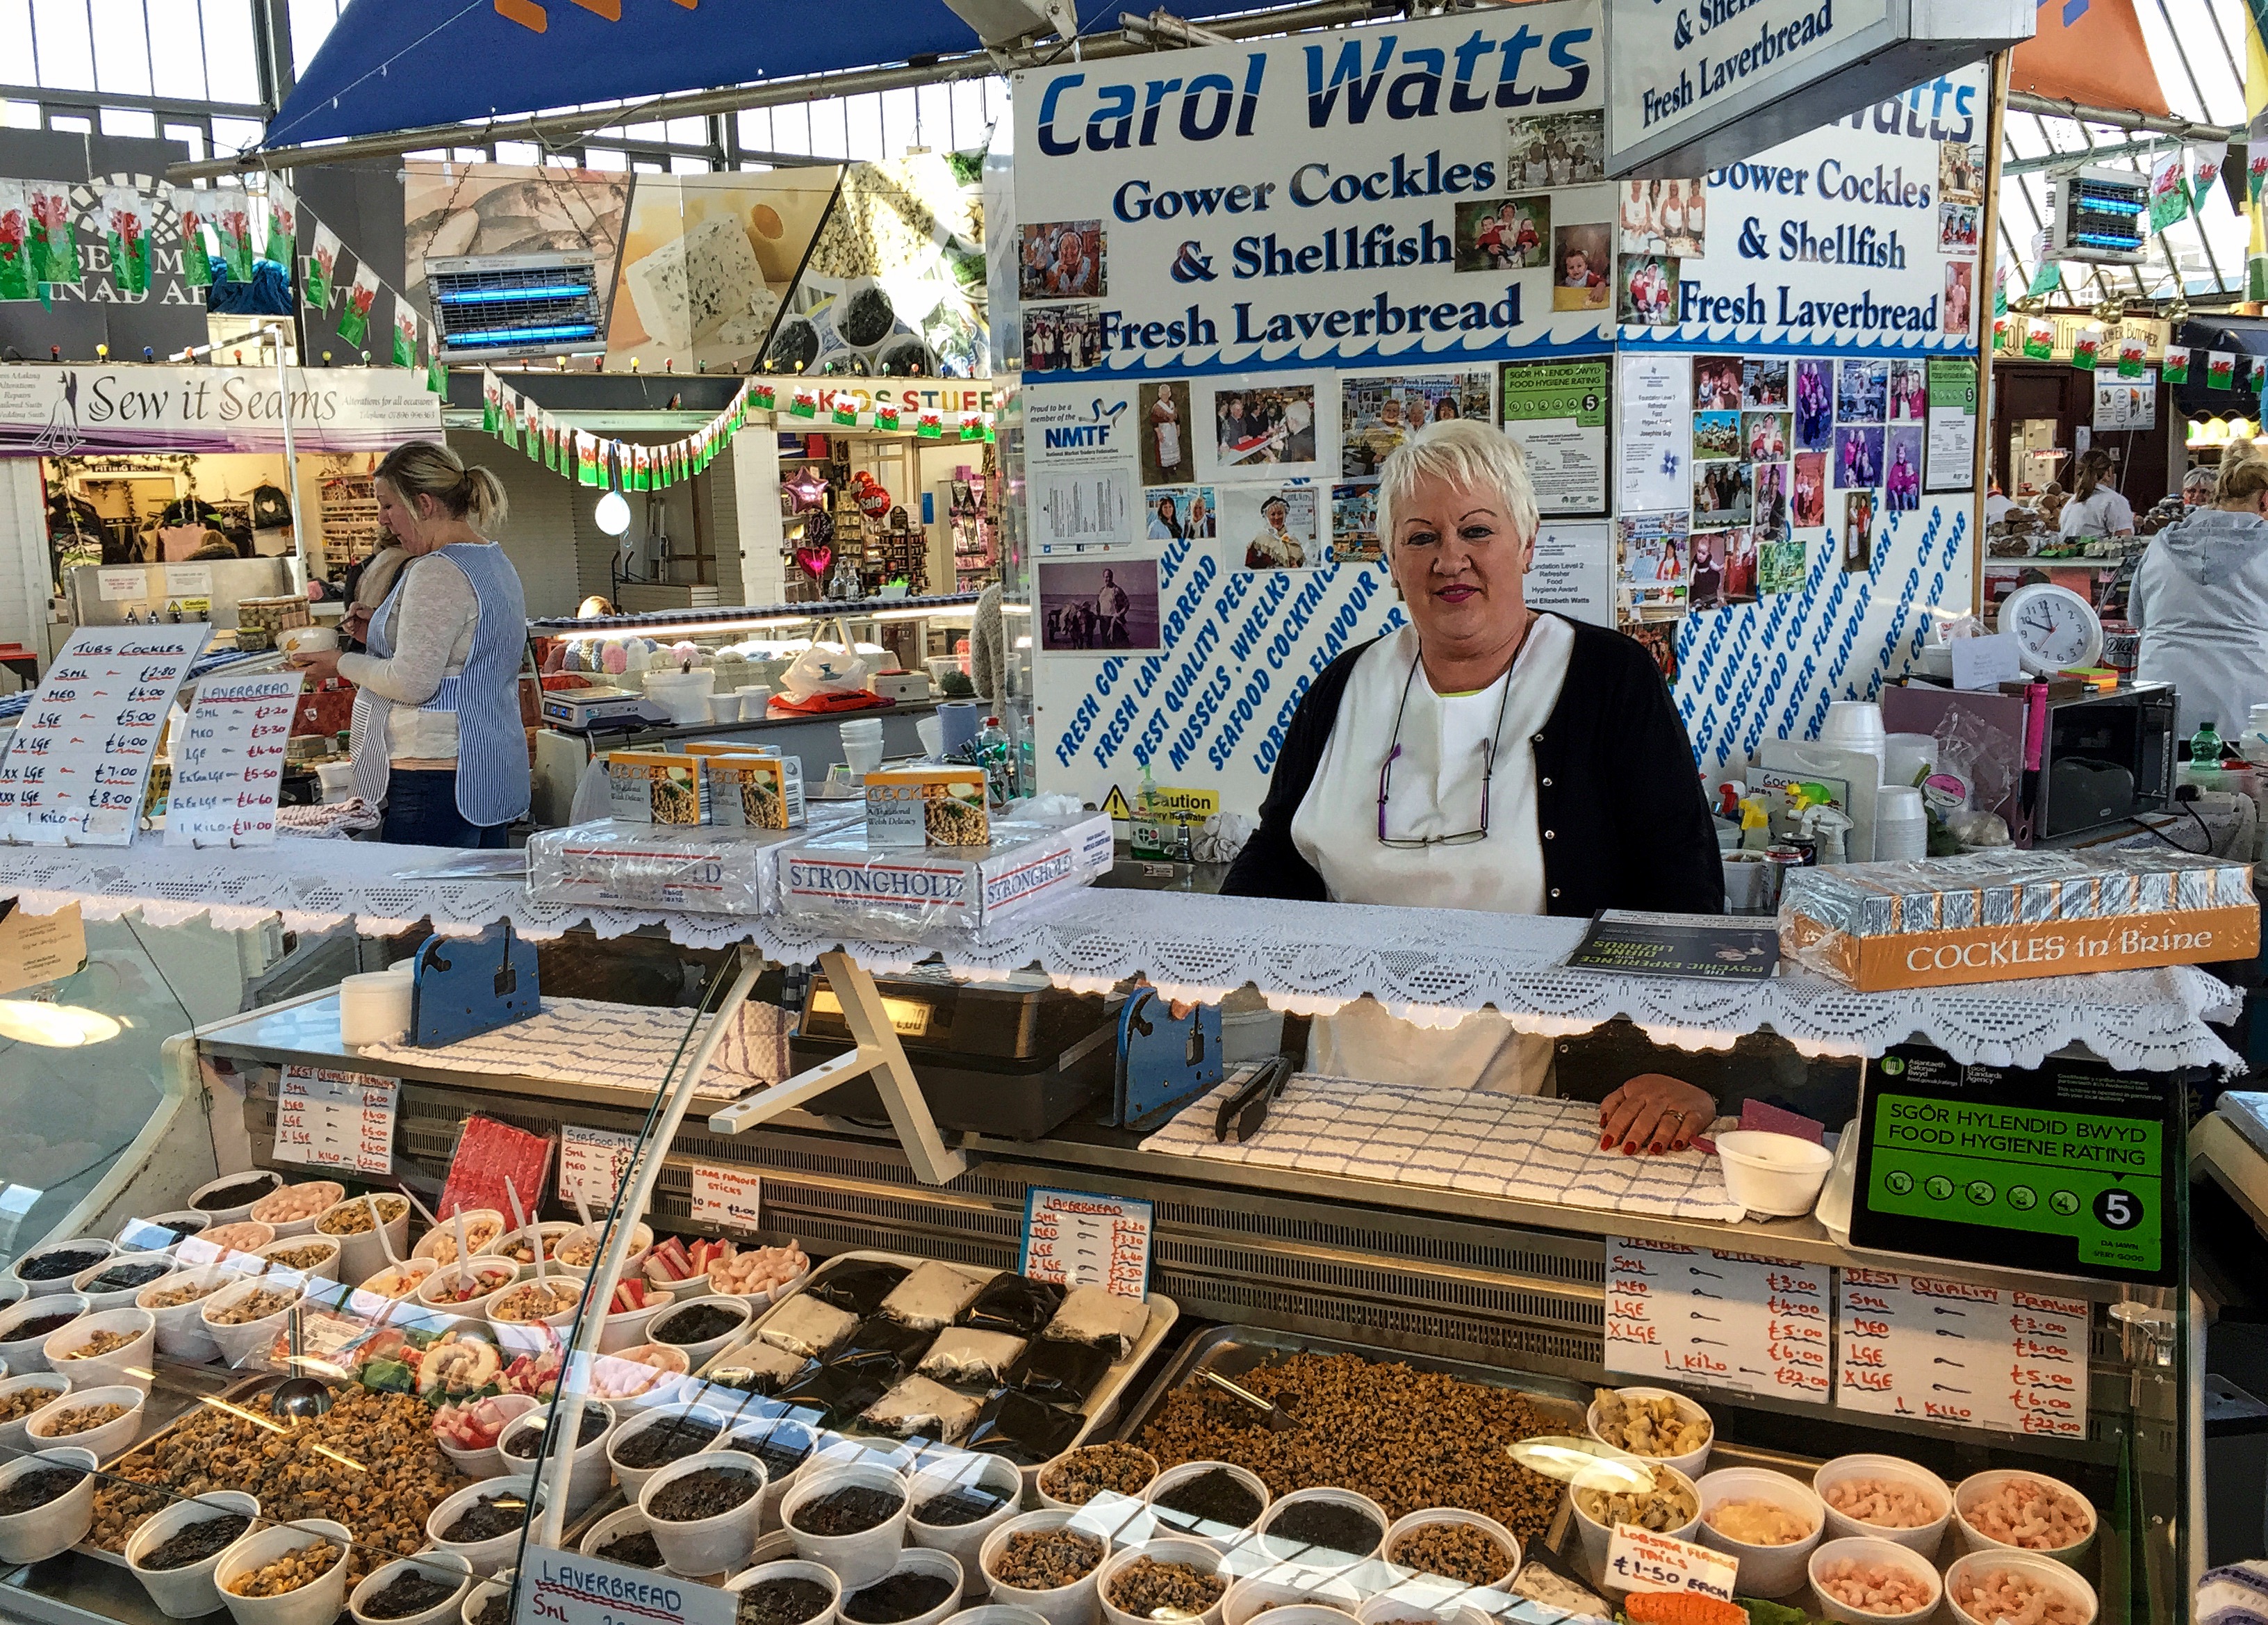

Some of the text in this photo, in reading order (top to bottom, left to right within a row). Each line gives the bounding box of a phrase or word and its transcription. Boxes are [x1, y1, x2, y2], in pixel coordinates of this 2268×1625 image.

[1673, 8, 1694, 51] &
[1643, 67, 1693, 129] Fresh
[1699, 0, 1833, 99] Laverbread
[1038, 24, 1593, 157] Carol Watts
[1114, 151, 1495, 223] Gower Cockles
[1817, 158, 1930, 209] Cockles
[1170, 220, 1455, 284] & Shellfish
[1738, 217, 1907, 270] & Shellfish
[1100, 282, 1523, 351] Fresh Laverbread
[1679, 279, 1938, 332] Fresh Laverbread
[89, 376, 337, 421] Sew it Seams
[343, 395, 434, 407] Alterations for all occasions
[819, 389, 891, 412] KDS
[1510, 376, 1601, 389] FOOD HYGIENE RATING
[1586, 395, 1595, 411] 5
[1030, 405, 1049, 414] Proud
[1030, 414, 1056, 423] member
[1057, 414, 1065, 422] of
[1045, 425, 1111, 449] NMTF
[860, 496, 882, 509] Sale
[1941, 510, 1967, 572] CRAB
[1828, 584, 1872, 689] FLAVOUR
[1868, 526, 1893, 585] FISH
[1879, 505, 1943, 671] DRESSED CRAB
[1308, 570, 1380, 676] FLAVOUR
[1743, 527, 1836, 761] SEAFOOD COCKTAILS
[73, 642, 185, 654] TUBS COCKLES
[1207, 667, 1270, 772] SEAFOOD
[1266, 544, 1342, 670] COCKTAILS
[1714, 608, 1757, 706] QUALITY
[2106, 636, 2135, 655] Diet
[202, 683, 290, 699] LAVERBREAD
[1132, 708, 1171, 768] BEST
[1163, 618, 1220, 713] QUALITY
[1167, 571, 1290, 773] MUSSELS WHELKS
[1716, 652, 1762, 767] MUSSELS
[1777, 653, 1818, 740] OBSTER
[38, 712, 62, 726] LGE
[1055, 694, 1101, 768] FRESH
[1092, 694, 1140, 769] FRESH
[30, 737, 52, 752] LGE
[186, 748, 206, 765] LGE
[23, 767, 46, 780] LGE
[20, 791, 40, 804] LGE
[790, 865, 964, 898] STRONGHOLD
[987, 856, 1072, 904] STRONGHOLD
[1579, 955, 1764, 973] EXPERIENCE PSYCHIC
[1907, 929, 2212, 972] COCKLES in Brine
[1966, 1075, 1994, 1085] Agency
[1891, 1103, 2147, 1144] SGÔR HYLENDID BWYD
[1889, 1124, 2146, 1166] FOOD HYGIENE RATING
[2105, 1195, 2131, 1225] 5
[2117, 1252, 2145, 1263] GOOD
[1615, 1300, 1644, 1318] LGE
[1608, 1321, 1656, 1344] X LGE
[1851, 1344, 1883, 1364] LGE
[542, 1560, 682, 1612] LAVERBREAD
